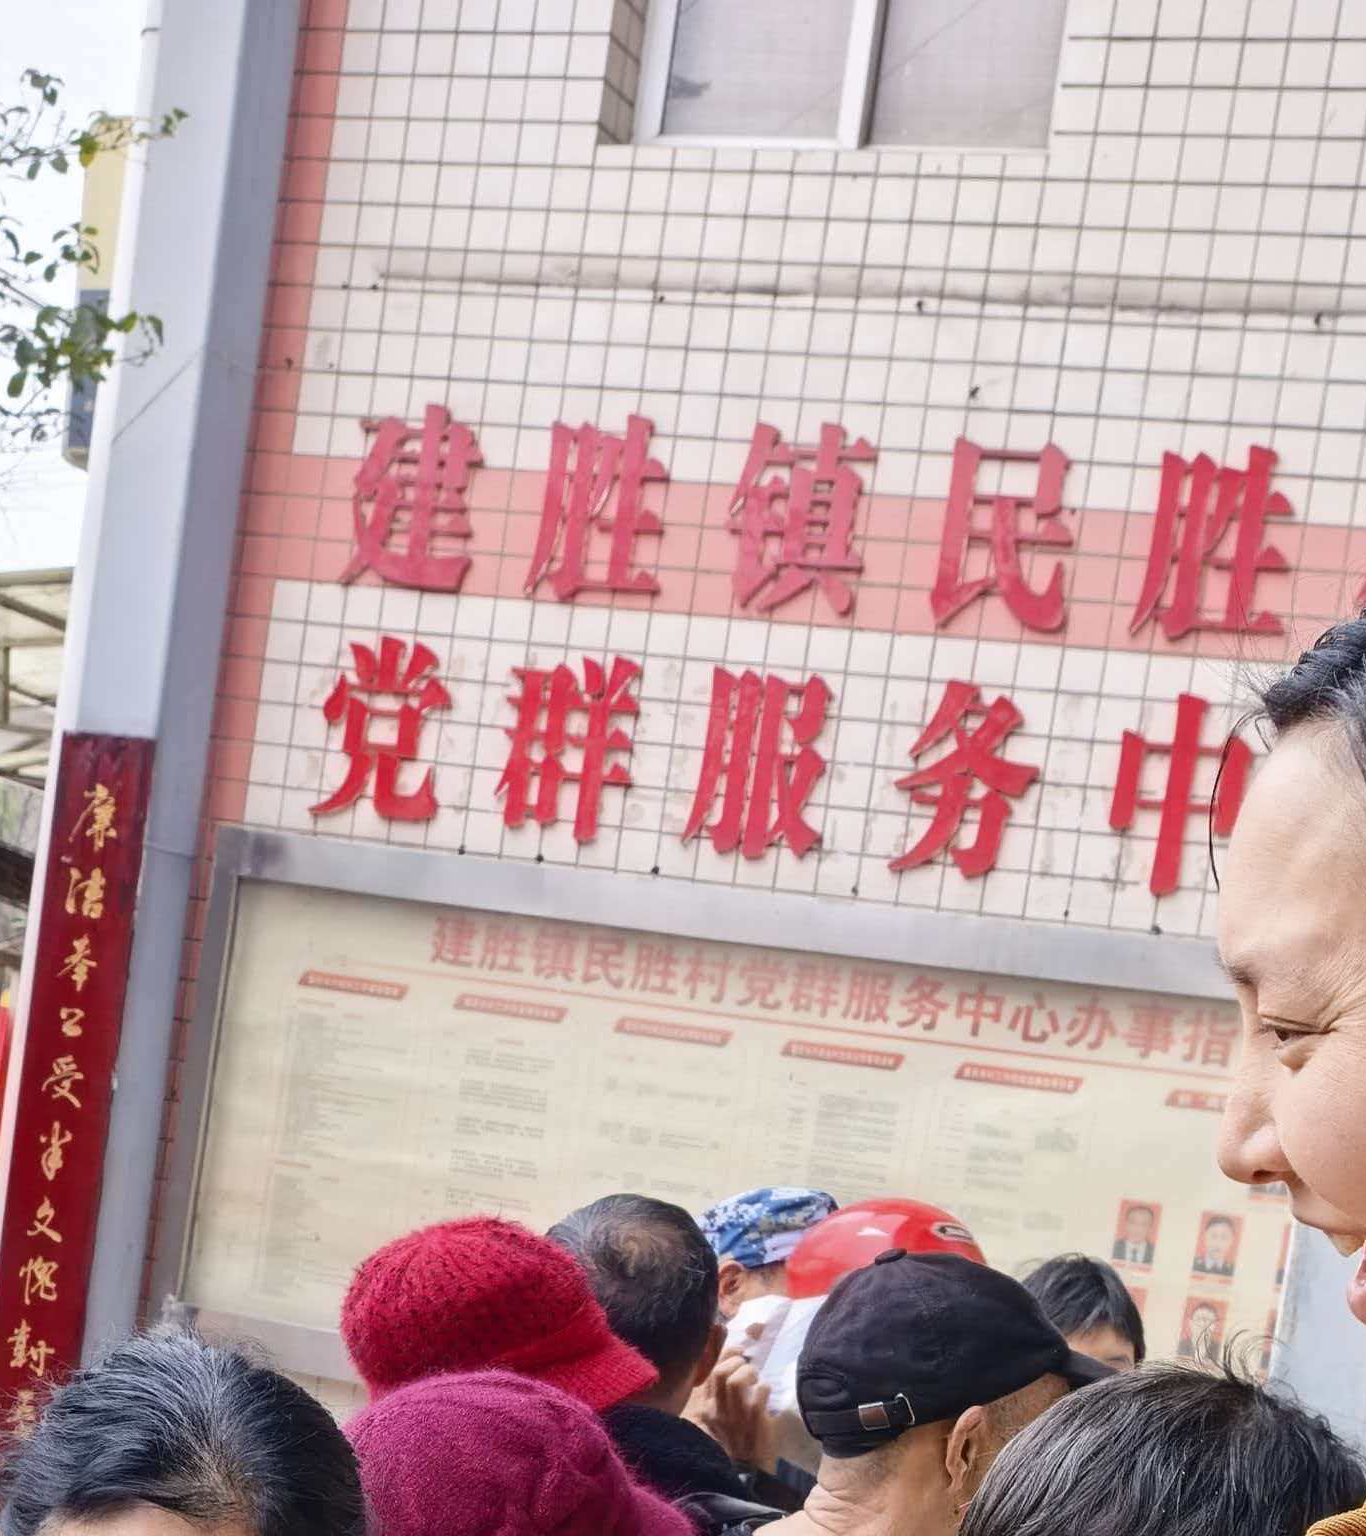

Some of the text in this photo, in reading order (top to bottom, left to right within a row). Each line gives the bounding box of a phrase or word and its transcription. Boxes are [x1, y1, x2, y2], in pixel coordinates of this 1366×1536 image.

[310, 635, 1253, 896] 党群服务中
[430, 914, 1241, 1068] 建胜镇民胜村党群服务中心办事指
